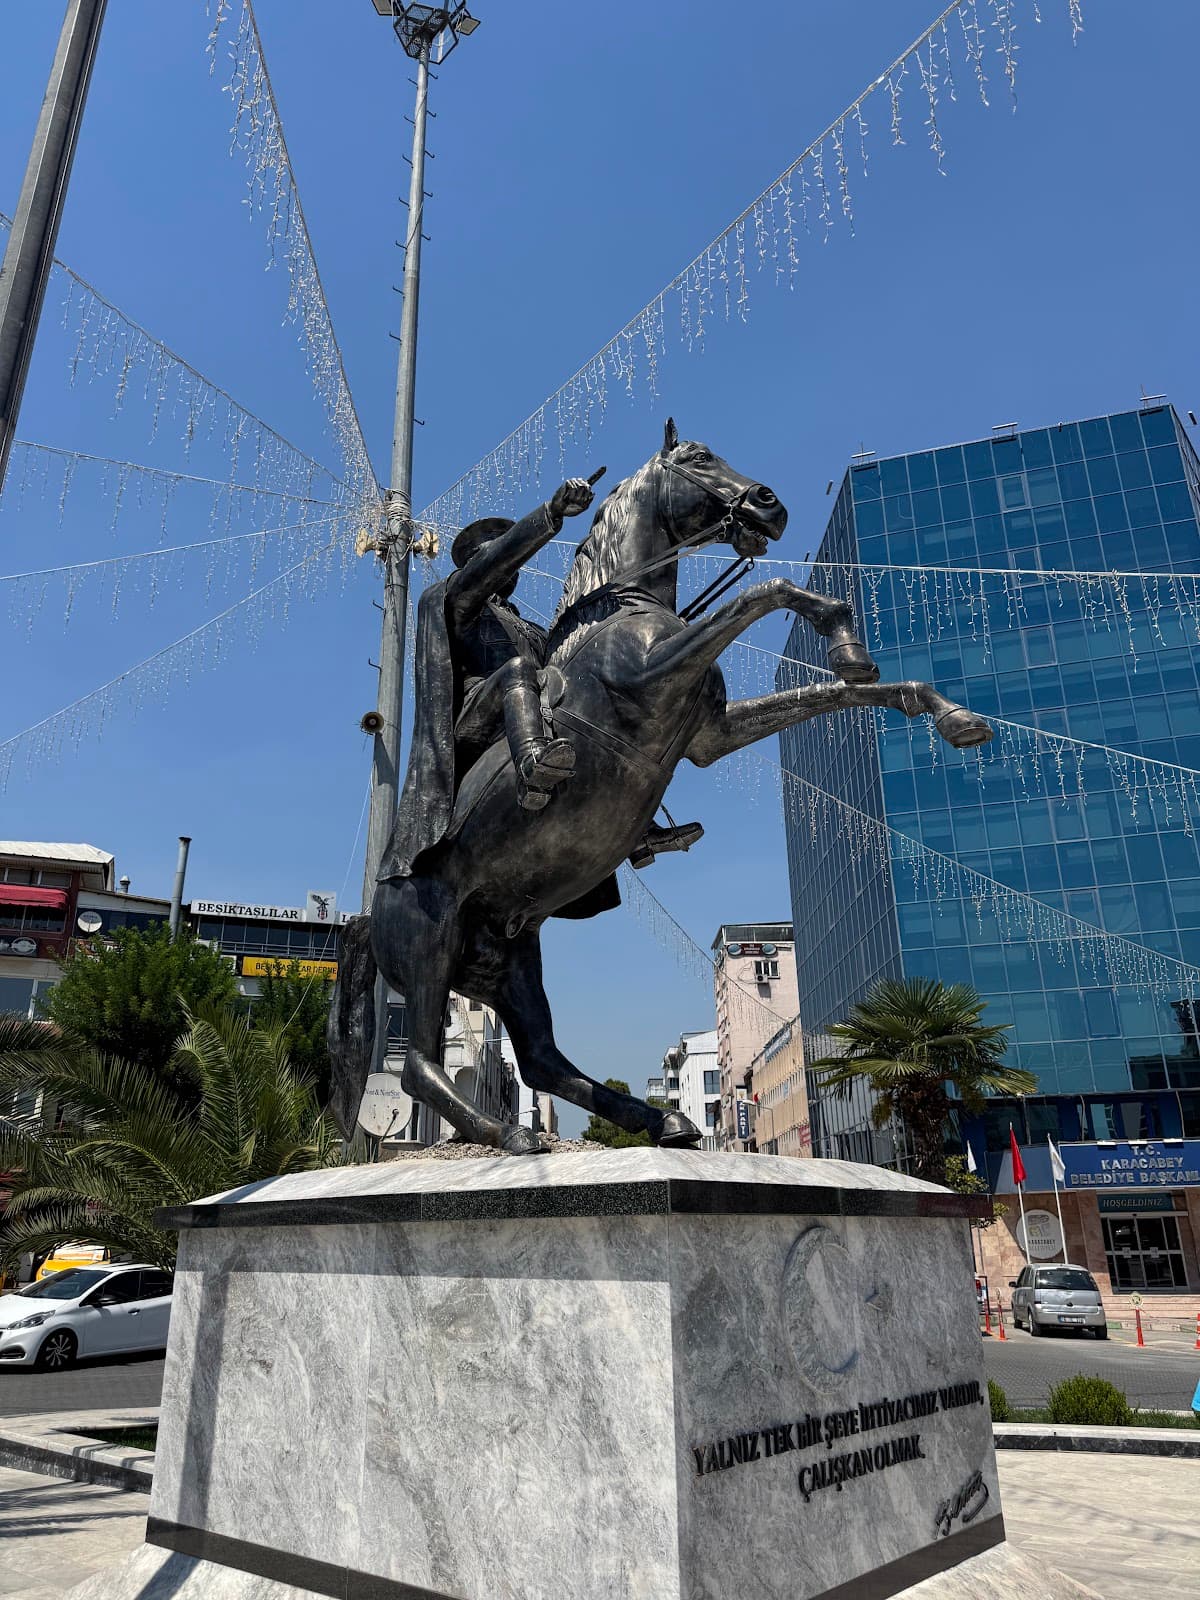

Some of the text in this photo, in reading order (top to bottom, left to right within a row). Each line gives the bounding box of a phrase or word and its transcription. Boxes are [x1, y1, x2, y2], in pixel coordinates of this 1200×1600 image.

[1131, 1145, 1161, 1156] T.C.
[1101, 1158, 1184, 1170] KARACABEY
[1070, 1170, 1135, 1185] BELEDİYE
[691, 1431, 761, 1477] YALNIZ
[761, 1423, 797, 1458] TEK
[796, 1413, 824, 1450] BİR
[824, 1409, 859, 1449] ŞEYE
[858, 1391, 939, 1431] İHTİYACIMIZ
[799, 1447, 874, 1503] ÇALIŞKAN
